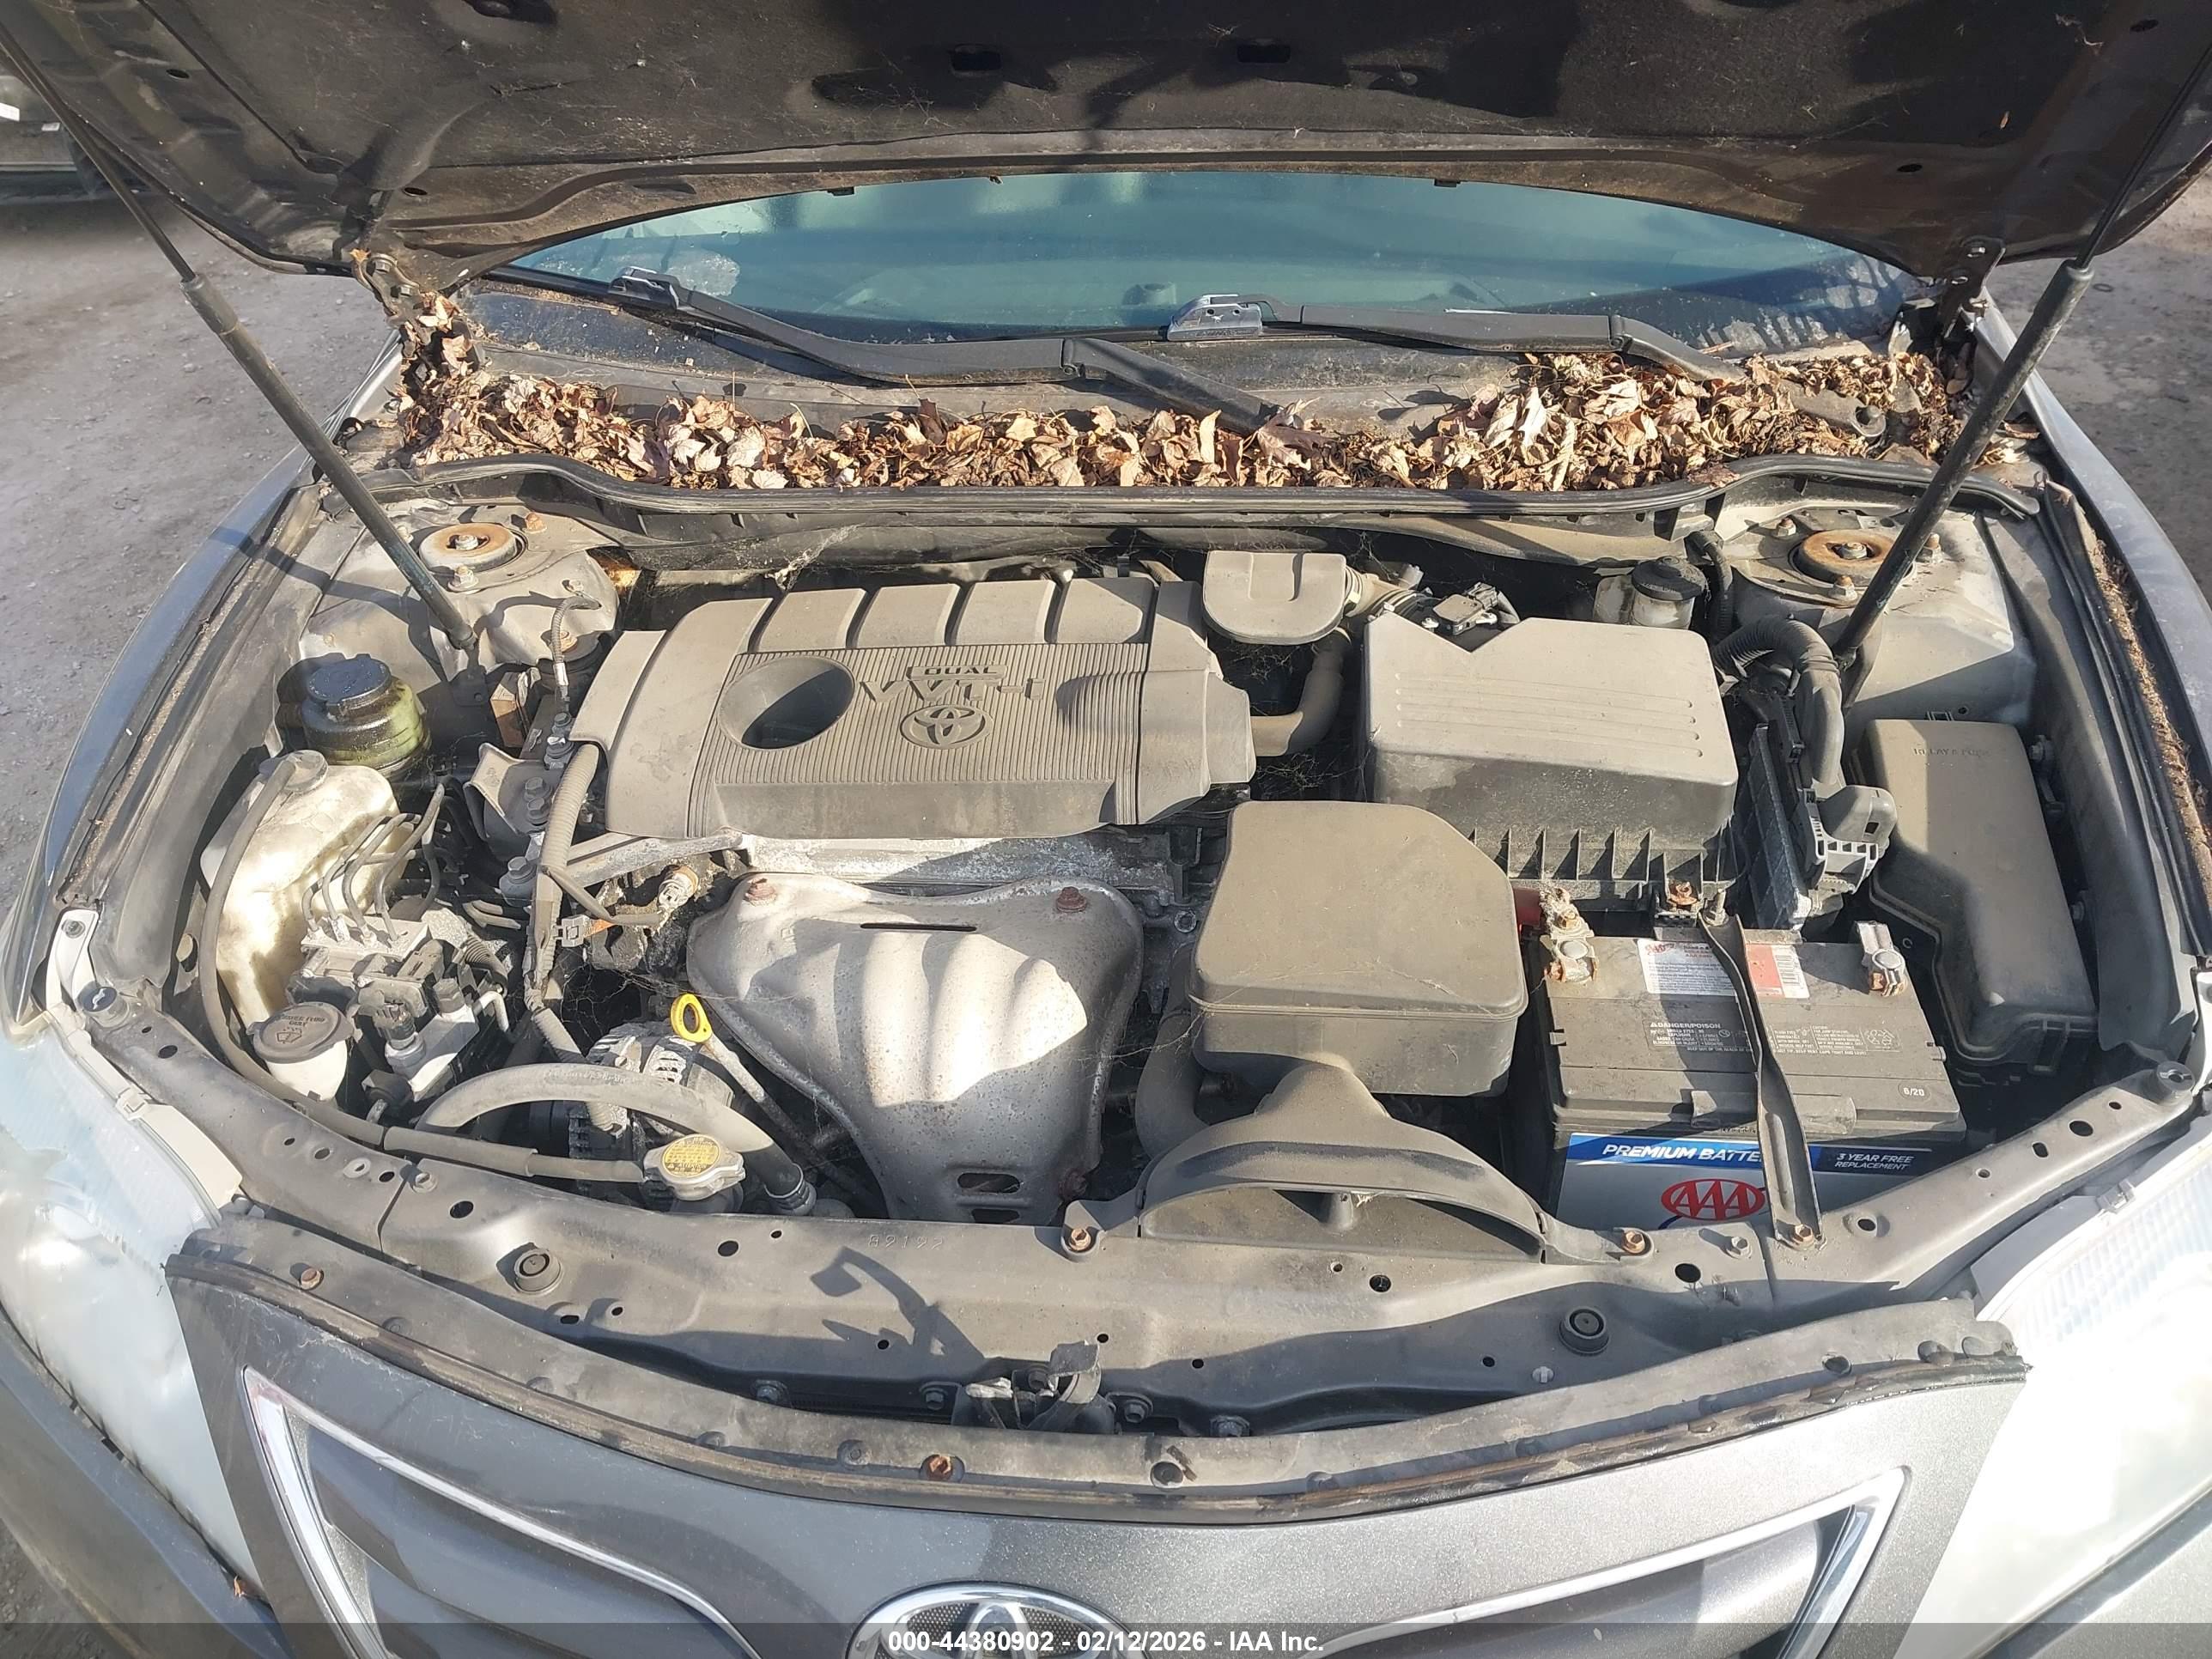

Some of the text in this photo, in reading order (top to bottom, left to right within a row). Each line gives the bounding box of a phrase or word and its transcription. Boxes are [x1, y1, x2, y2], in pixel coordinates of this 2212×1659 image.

[1602, 1144, 1762, 1163] PREMIUM BATTE
[1834, 1161, 1908, 1170] REPLACEMENT
[1672, 1181, 1758, 1218] AAA
